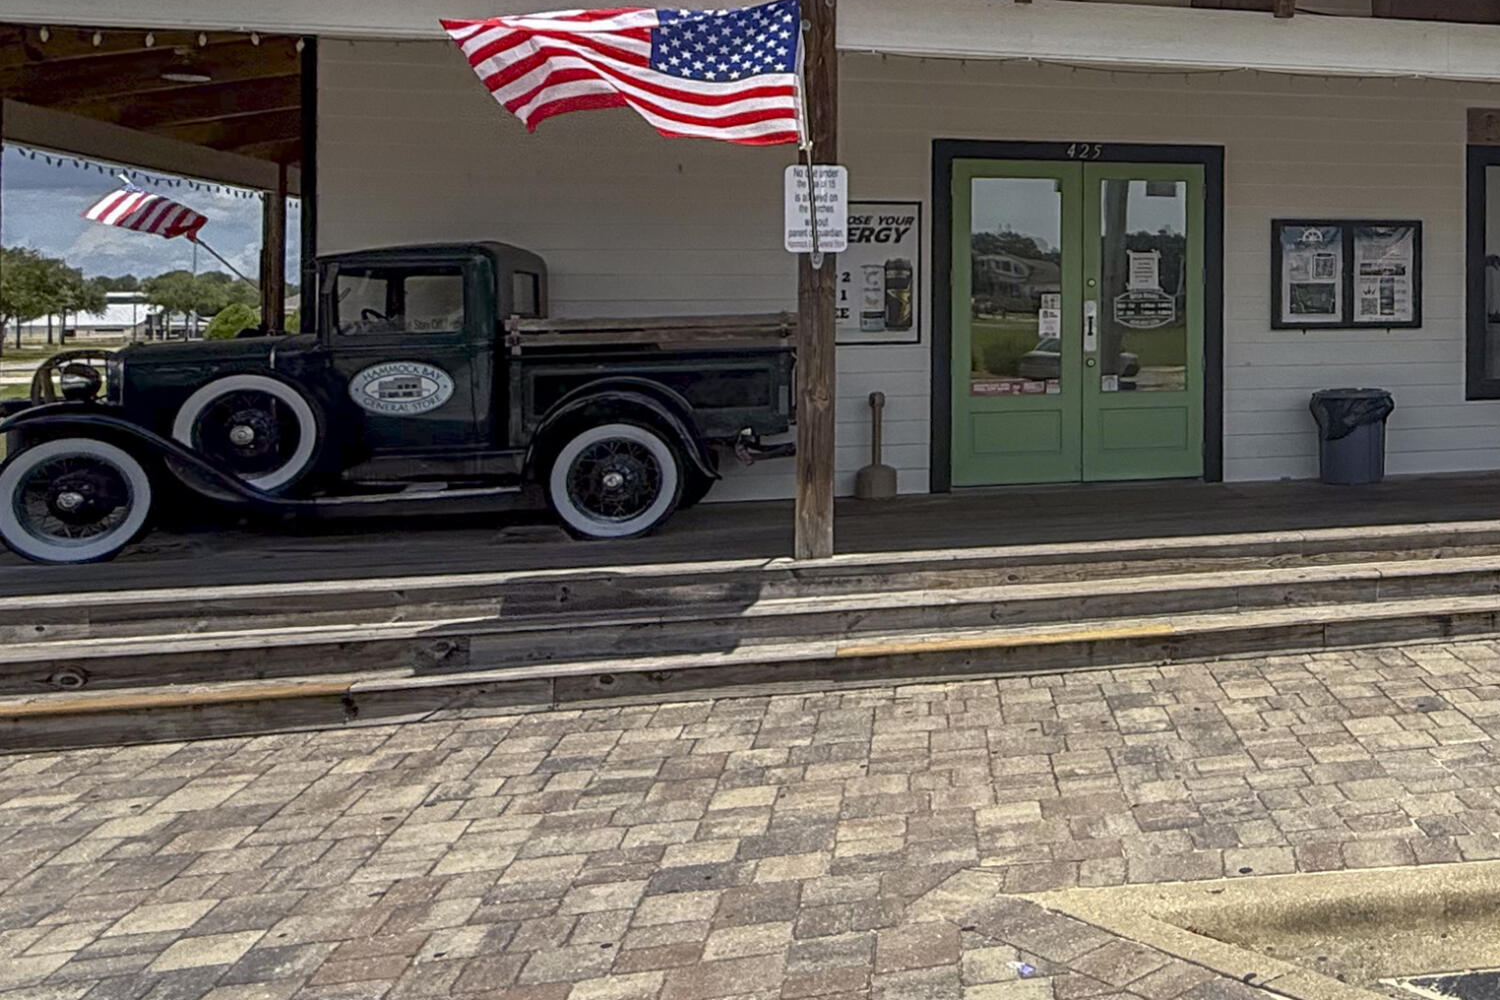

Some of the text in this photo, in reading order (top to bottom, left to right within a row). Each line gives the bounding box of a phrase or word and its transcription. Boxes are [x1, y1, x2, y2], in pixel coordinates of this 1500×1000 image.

[1067, 143, 1102, 159] 425
[793, 168, 803, 177] No
[878, 215, 915, 226] YOUR
[841, 272, 851, 282] 2
[363, 364, 443, 381] HAMMOCK BAY
